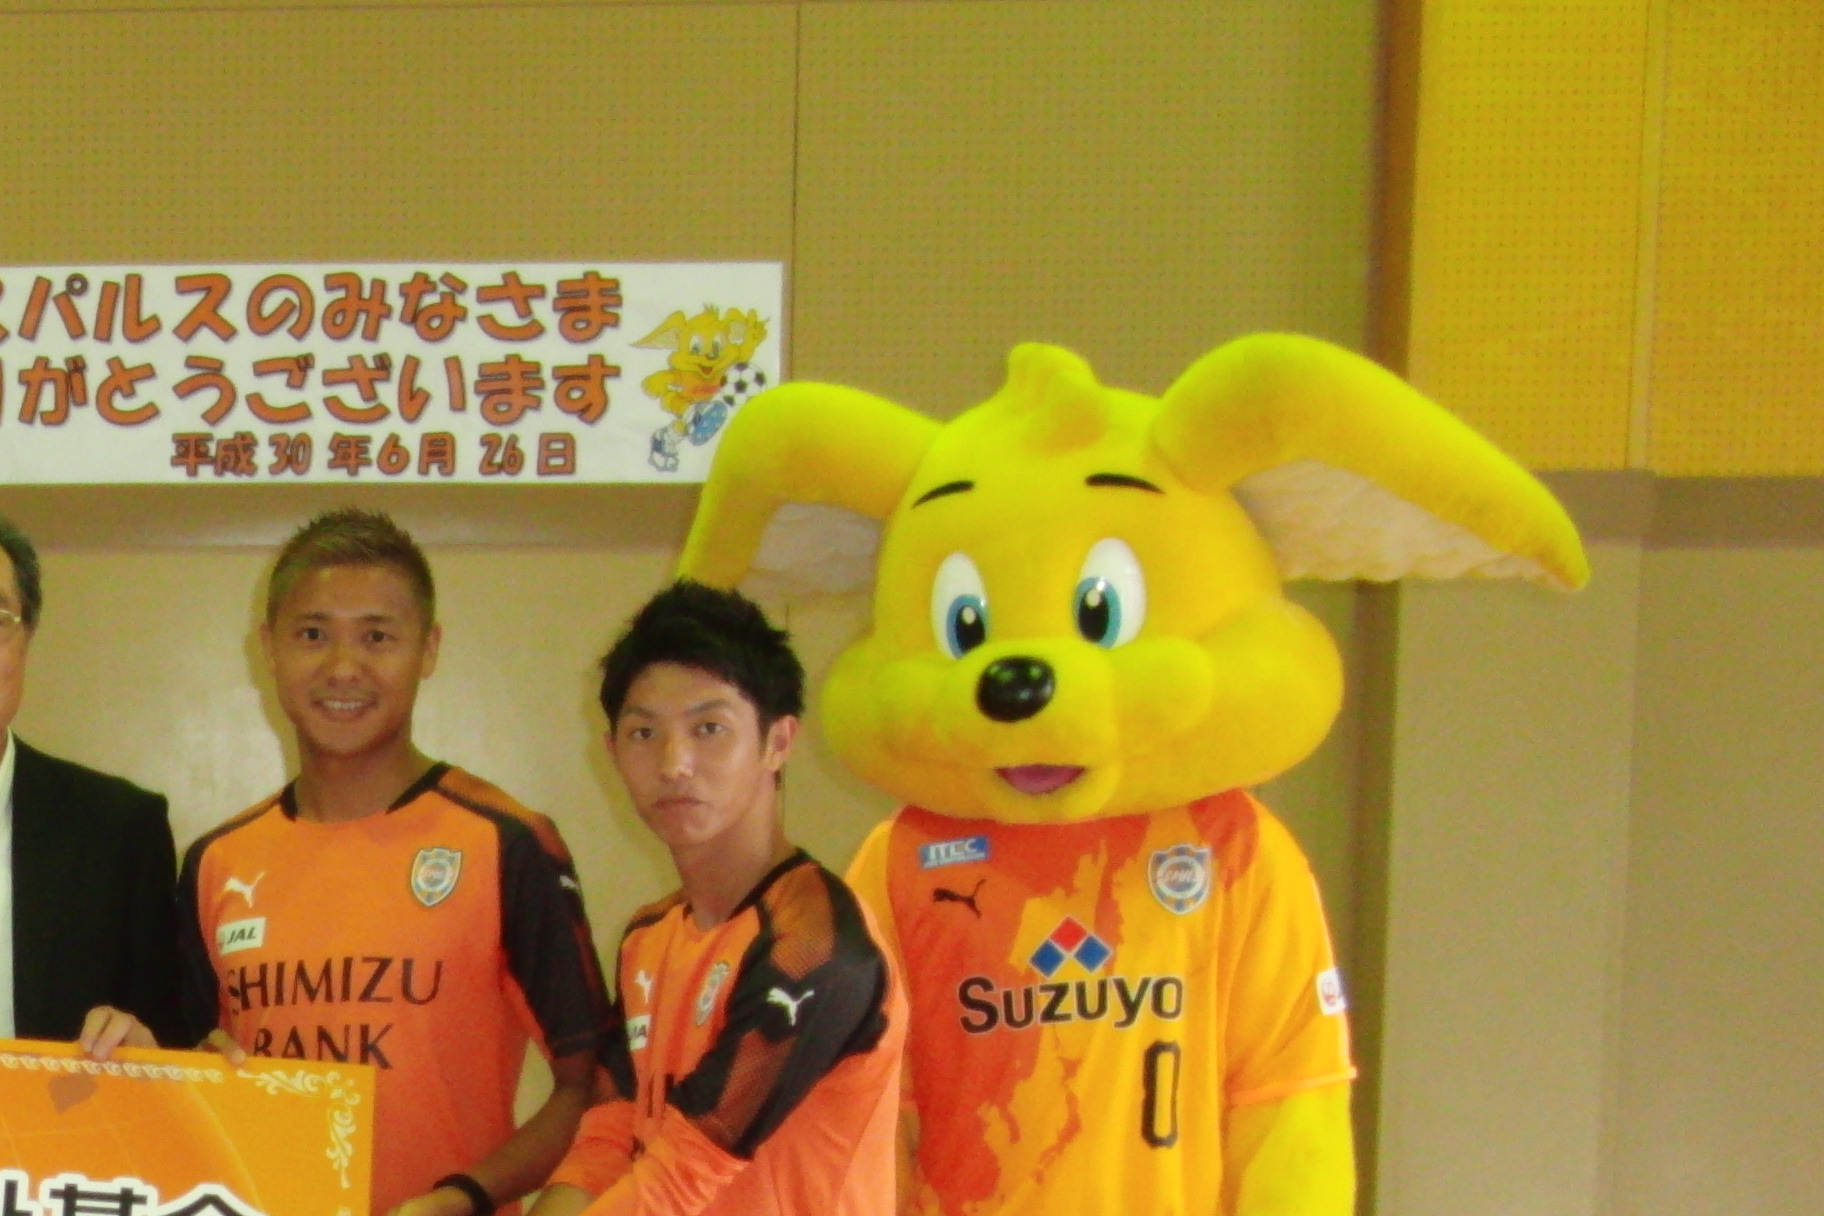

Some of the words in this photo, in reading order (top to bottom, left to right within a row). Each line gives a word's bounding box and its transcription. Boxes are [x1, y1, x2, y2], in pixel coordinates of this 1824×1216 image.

[226, 925, 258, 944] JAL
[958, 975, 1184, 1033] Suzuyo
[1142, 1039, 1182, 1149] 0
